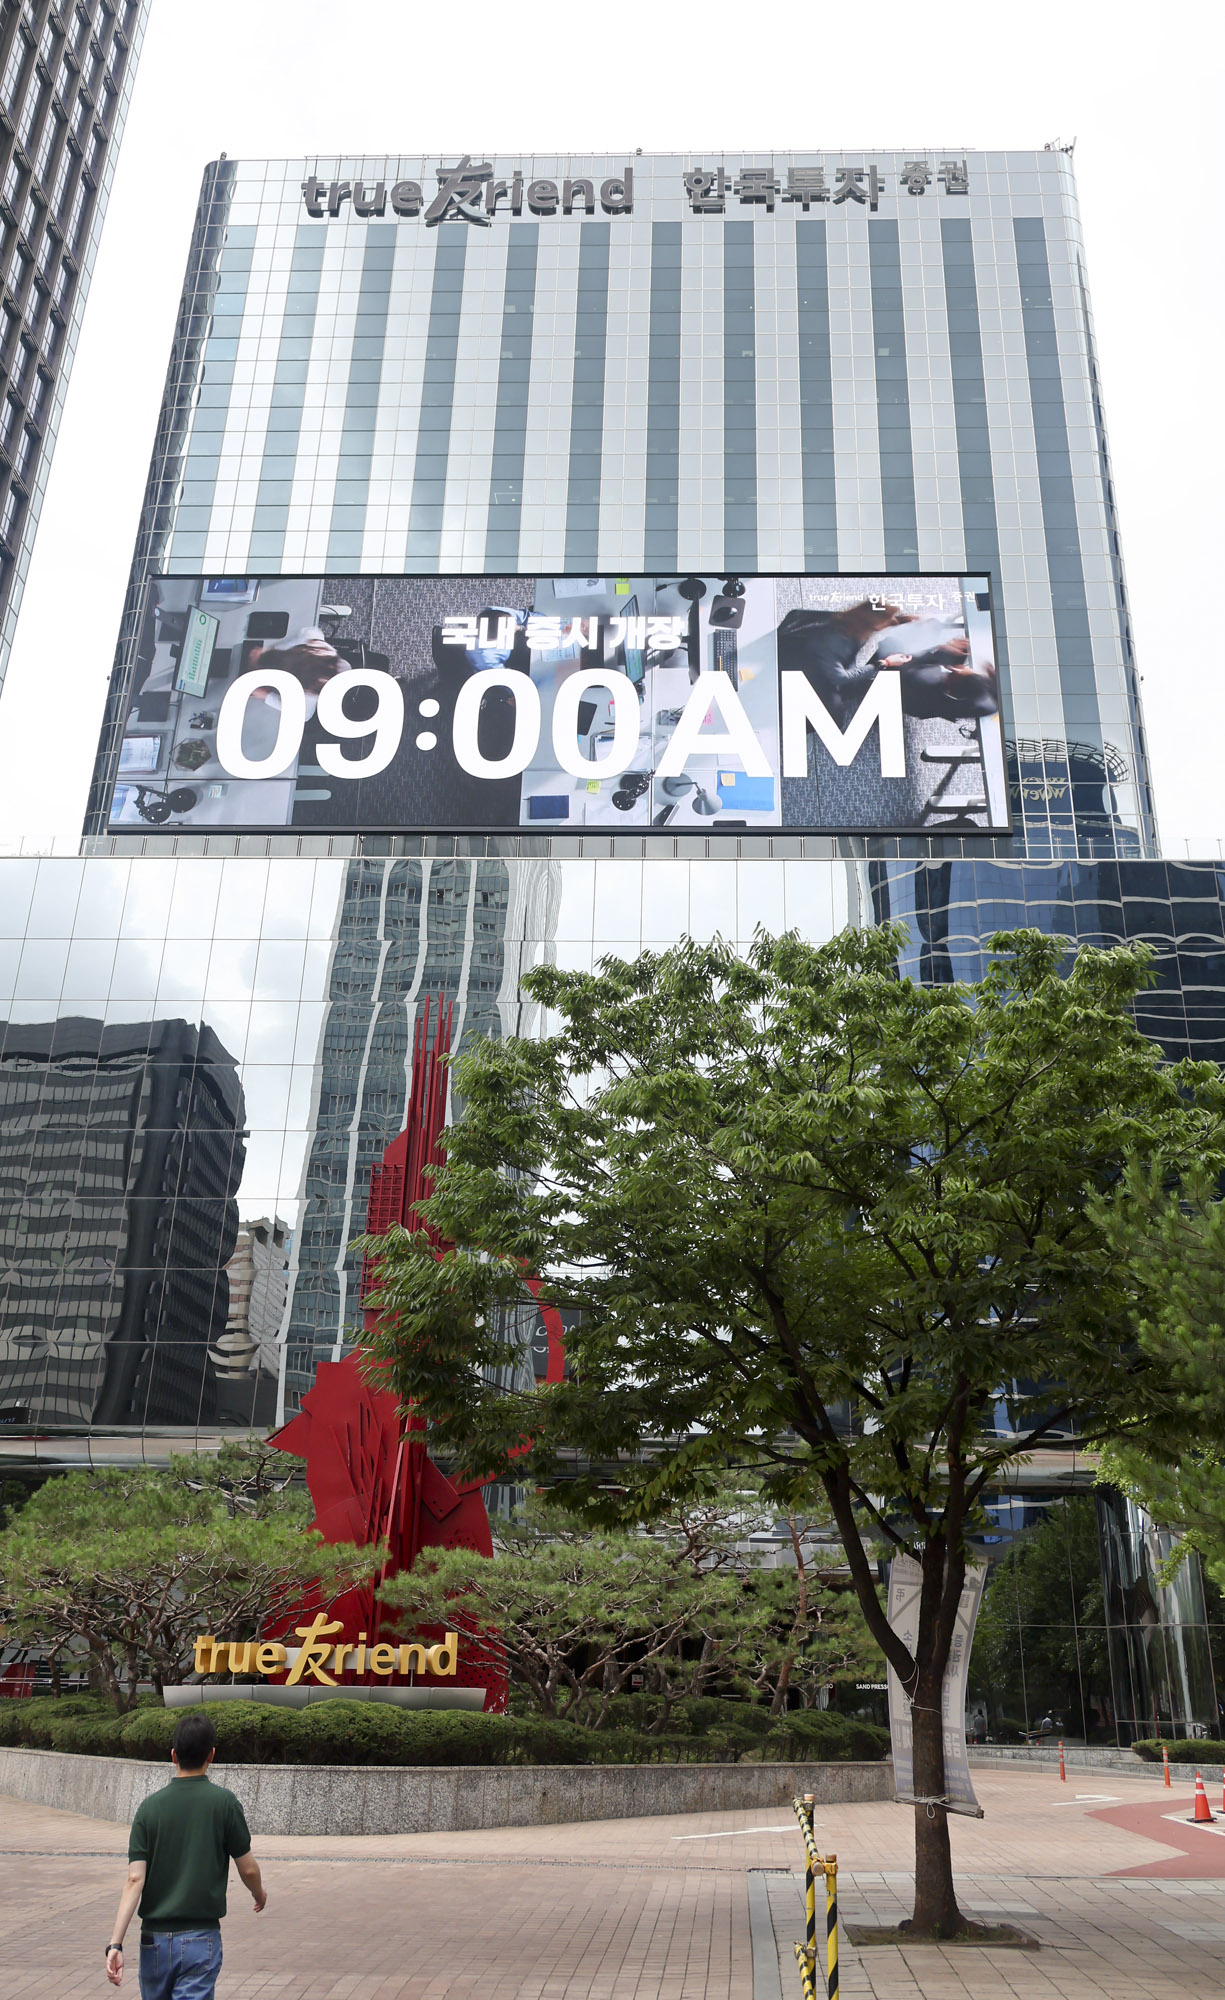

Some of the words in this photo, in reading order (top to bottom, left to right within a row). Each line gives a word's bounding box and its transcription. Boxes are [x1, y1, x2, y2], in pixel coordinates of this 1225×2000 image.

[682, 165, 885, 214] 한국투자
[900, 160, 970, 195] 증권
[868, 593, 944, 611] 한국투자
[951, 591, 976, 603] 증권
[441, 616, 516, 650] 국내
[525, 616, 598, 650] 증시
[609, 616, 688, 650] 개장
